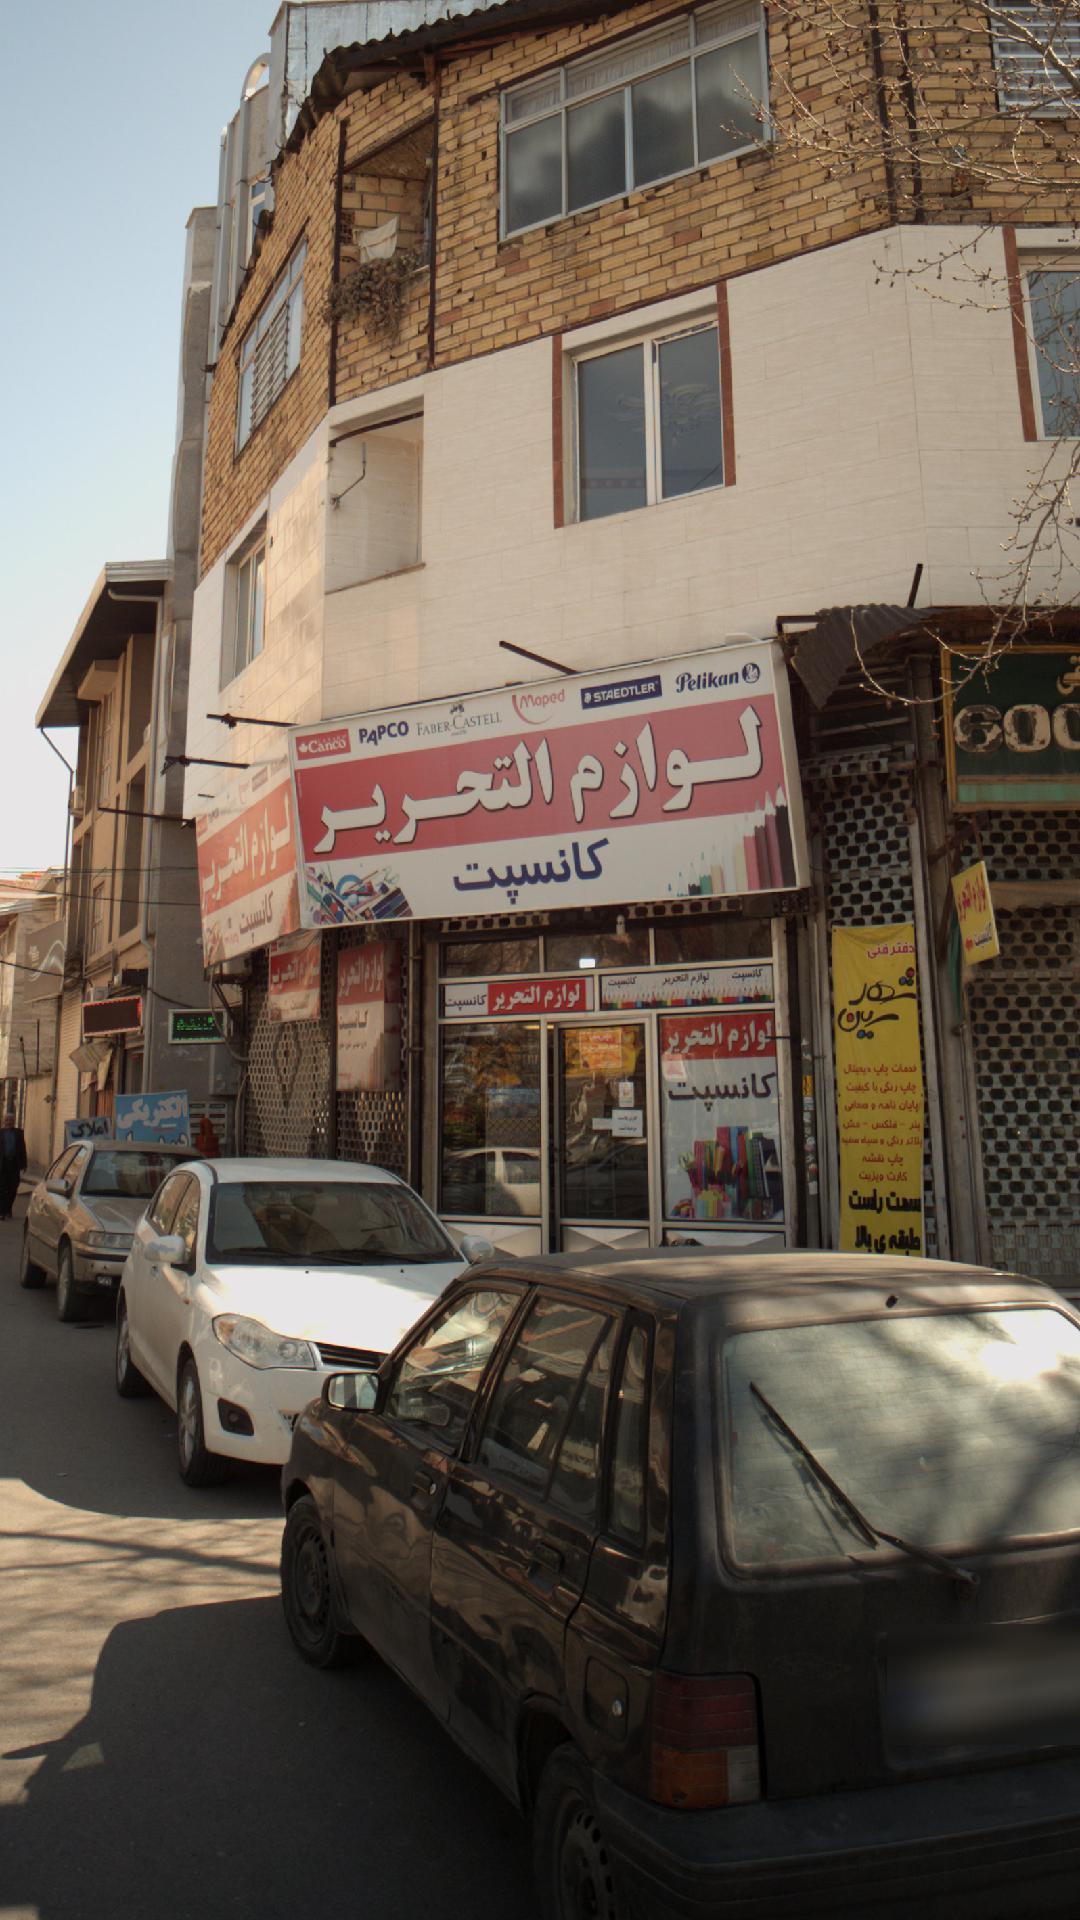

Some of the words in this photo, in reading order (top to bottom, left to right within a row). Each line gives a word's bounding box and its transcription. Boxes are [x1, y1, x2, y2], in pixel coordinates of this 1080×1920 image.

[593, 682, 656, 703] STAEDTLER
[676, 670, 739, 694] Pelikan
[358, 720, 410, 746] PAPCO
[307, 739, 347, 754] Canco
[570, 704, 765, 824] لوازم
[312, 735, 555, 855] التحریر
[452, 837, 611, 905] کانسپت
[867, 943, 889, 960] فنی
[889, 941, 915, 956] دفتر
[492, 985, 541, 1012] التحریر
[543, 983, 582, 1009] لوازم
[666, 1022, 723, 1055] التحریر
[667, 1071, 776, 1112] کانسپت
[848, 1188, 883, 1214] راست
